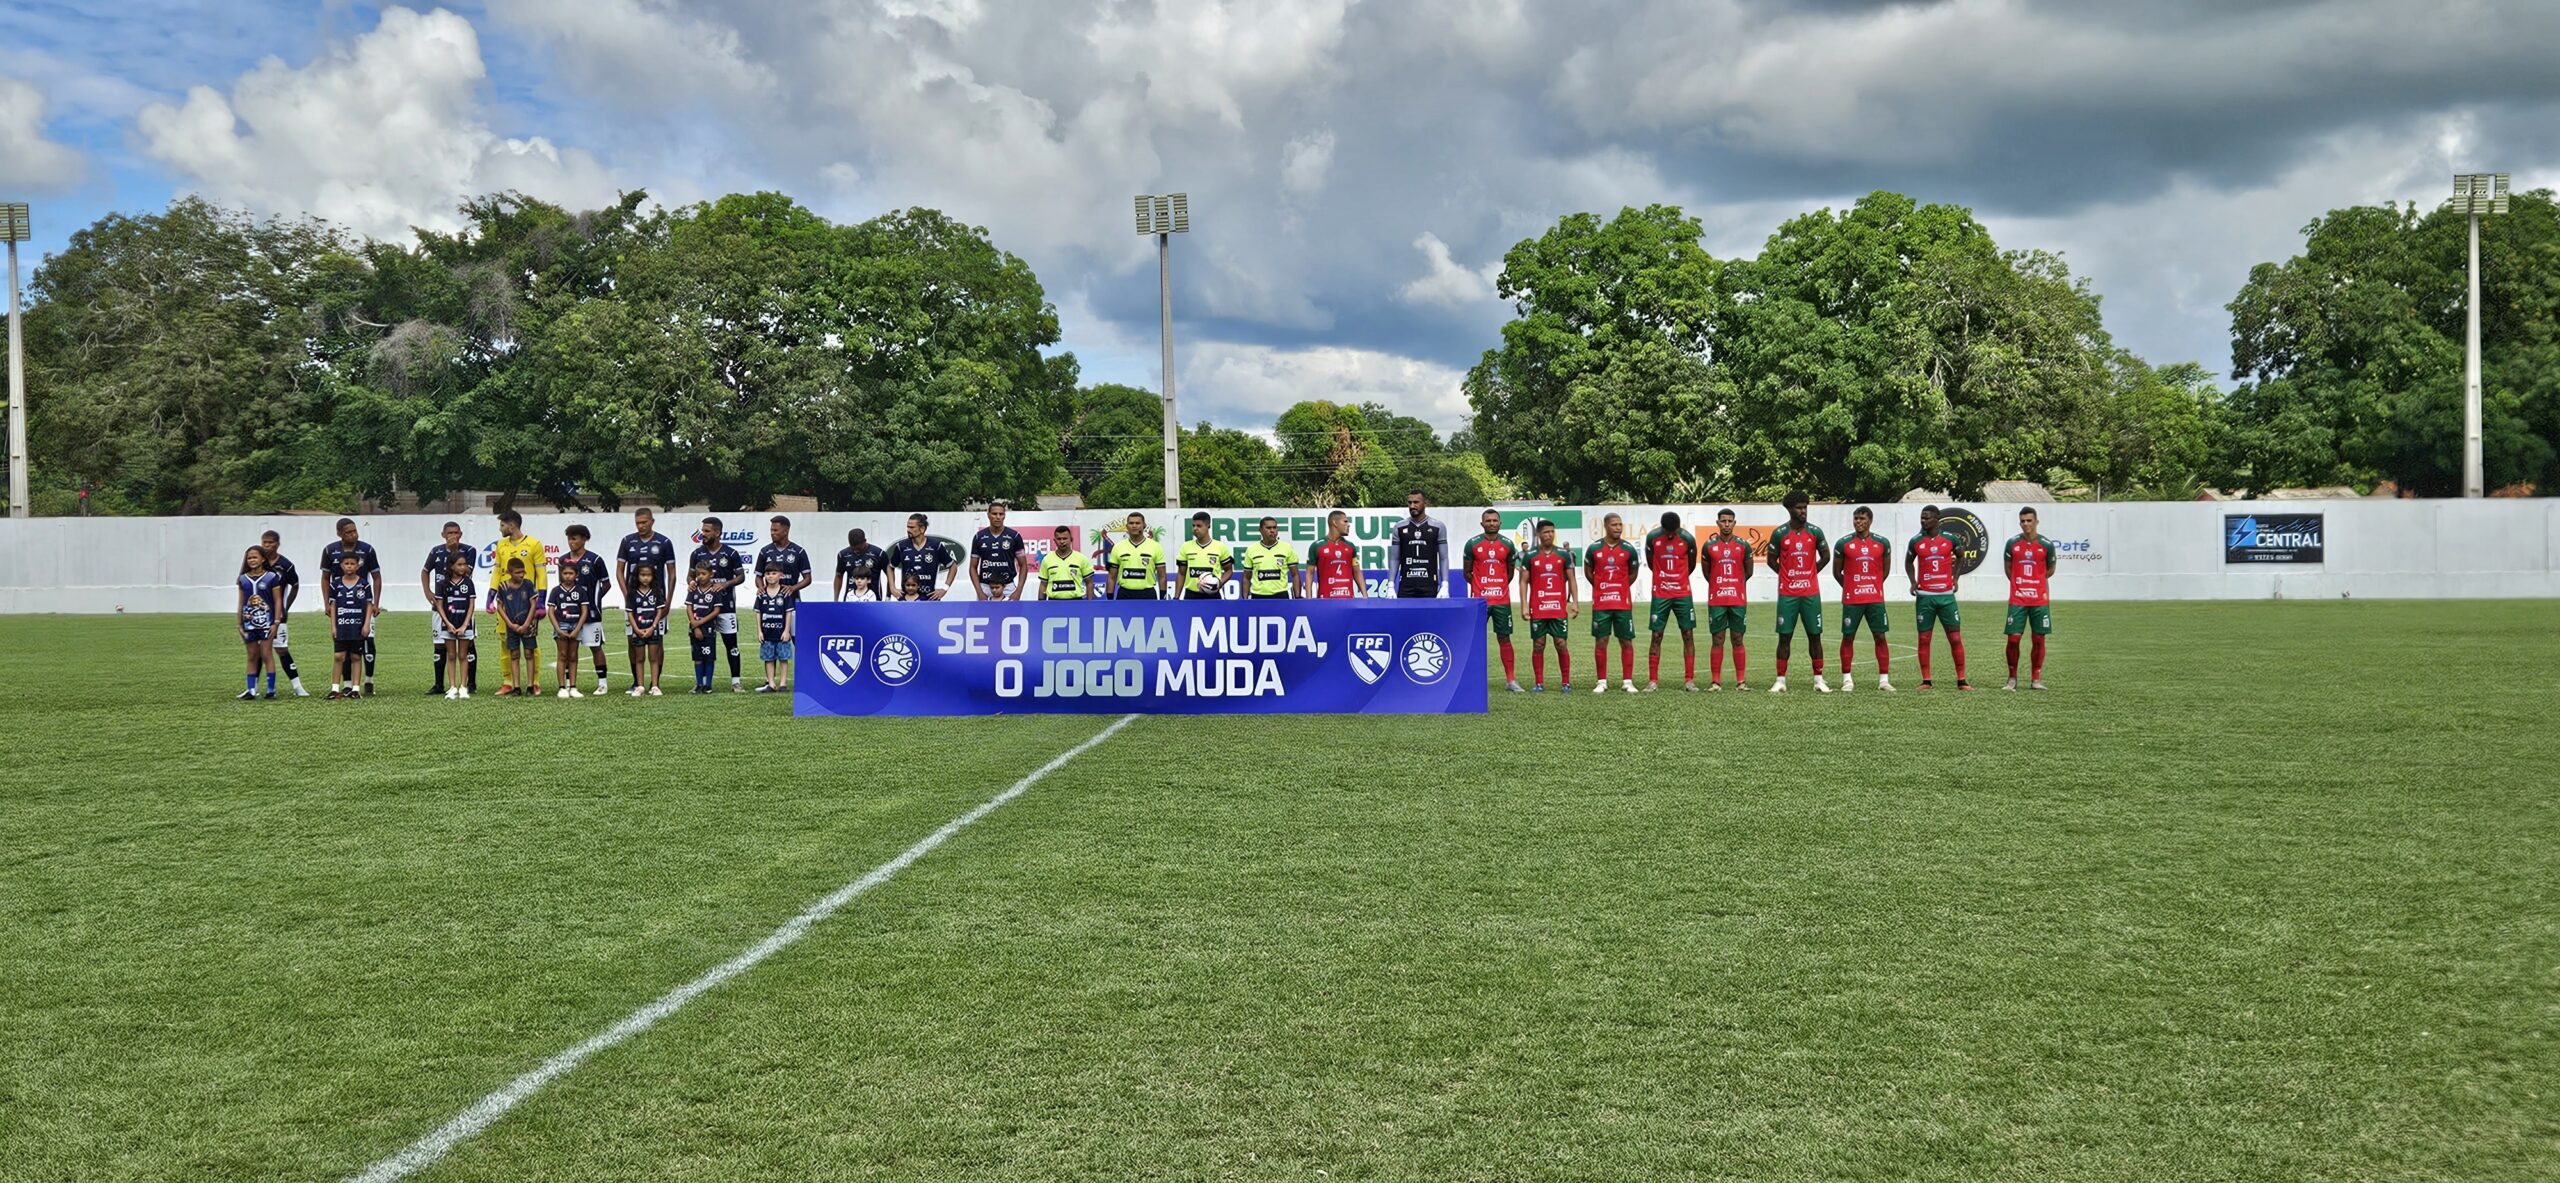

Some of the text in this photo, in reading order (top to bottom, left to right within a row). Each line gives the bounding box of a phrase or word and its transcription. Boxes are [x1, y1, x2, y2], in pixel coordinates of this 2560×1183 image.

[721, 529, 754, 541] LGÁS
[2256, 533, 2321, 547] CENTRAL
[2056, 553, 2103, 562] onstrução
[1336, 563, 1343, 575] 4
[1489, 564, 1495, 576] 6
[1723, 564, 1732, 575] 13
[1863, 561, 1868, 573] 8
[1547, 577, 1553, 589] 5
[938, 616, 1328, 658] SE O CLIMA MUDA,
[1356, 637, 1384, 649] FPF
[827, 639, 855, 651] FPF
[995, 659, 1285, 697] O JOGO MUDA
